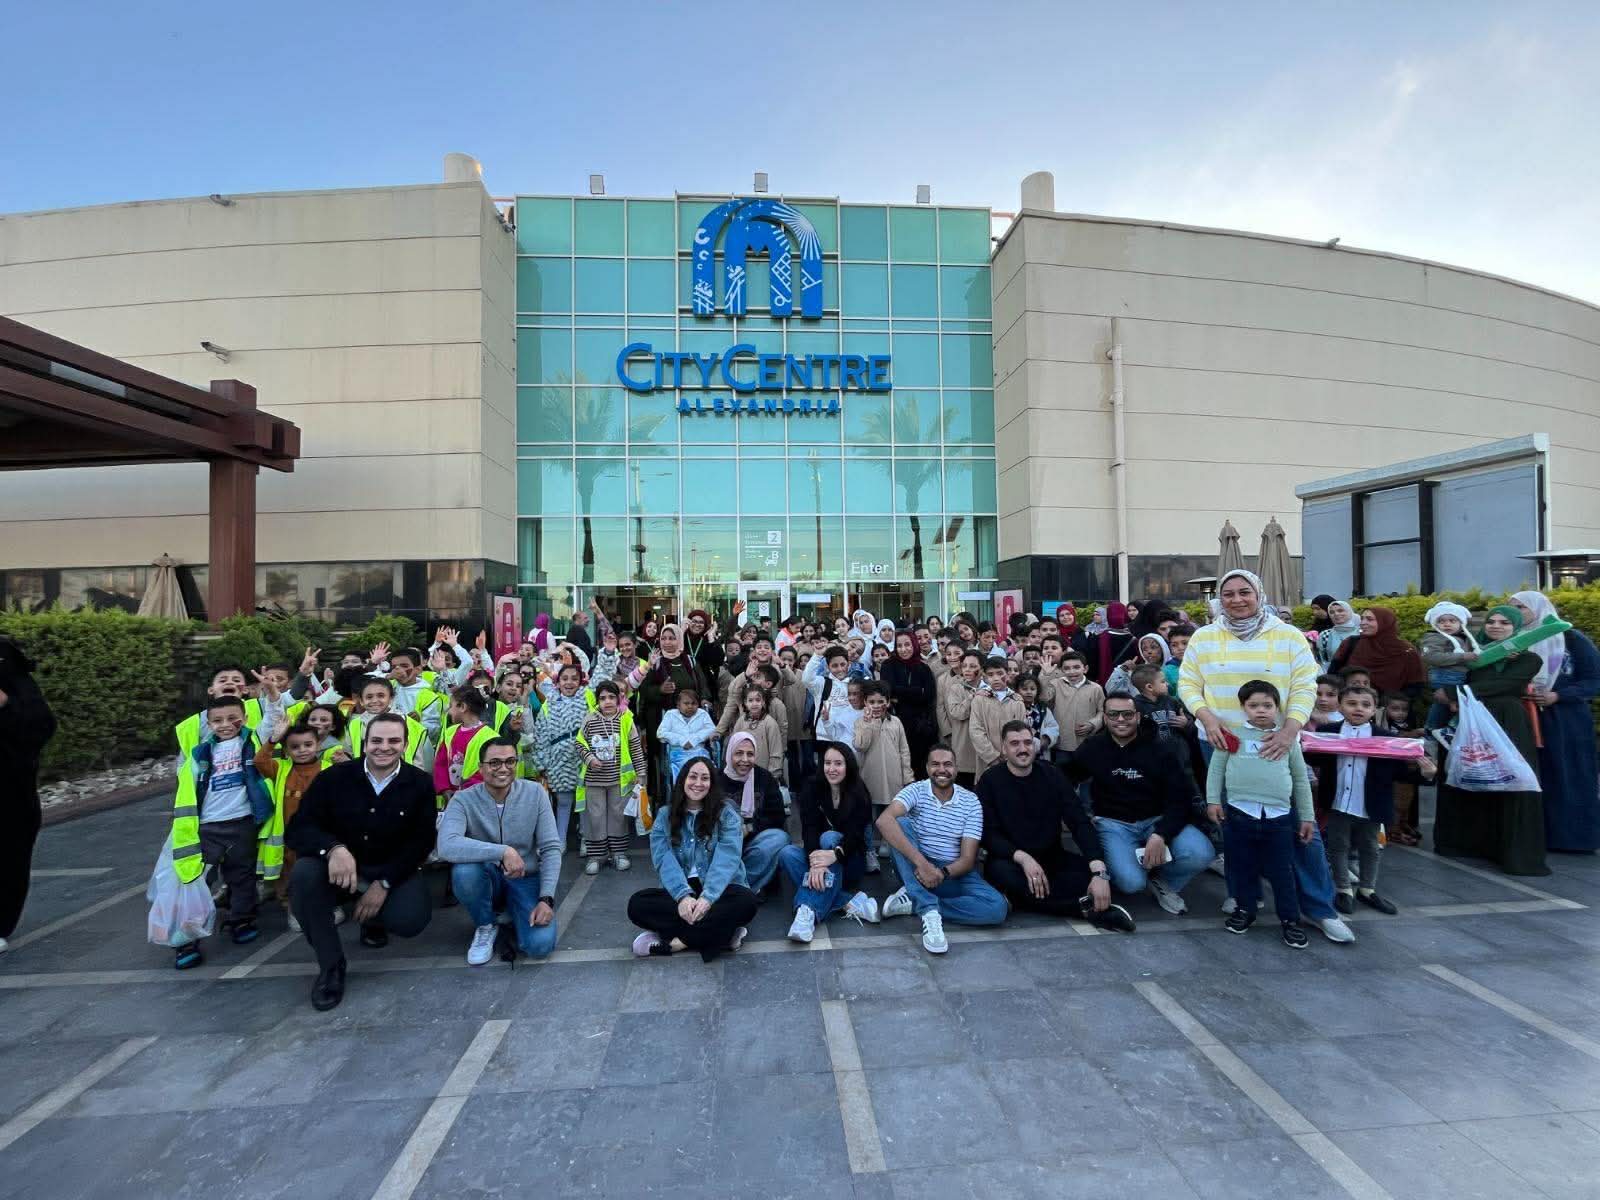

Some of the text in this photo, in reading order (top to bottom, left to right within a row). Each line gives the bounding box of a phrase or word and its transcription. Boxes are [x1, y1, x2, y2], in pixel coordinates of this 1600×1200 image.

[677, 397, 841, 415] ALEXANDRIA
[771, 550, 779, 560] B
[851, 562, 889, 574] Enter
